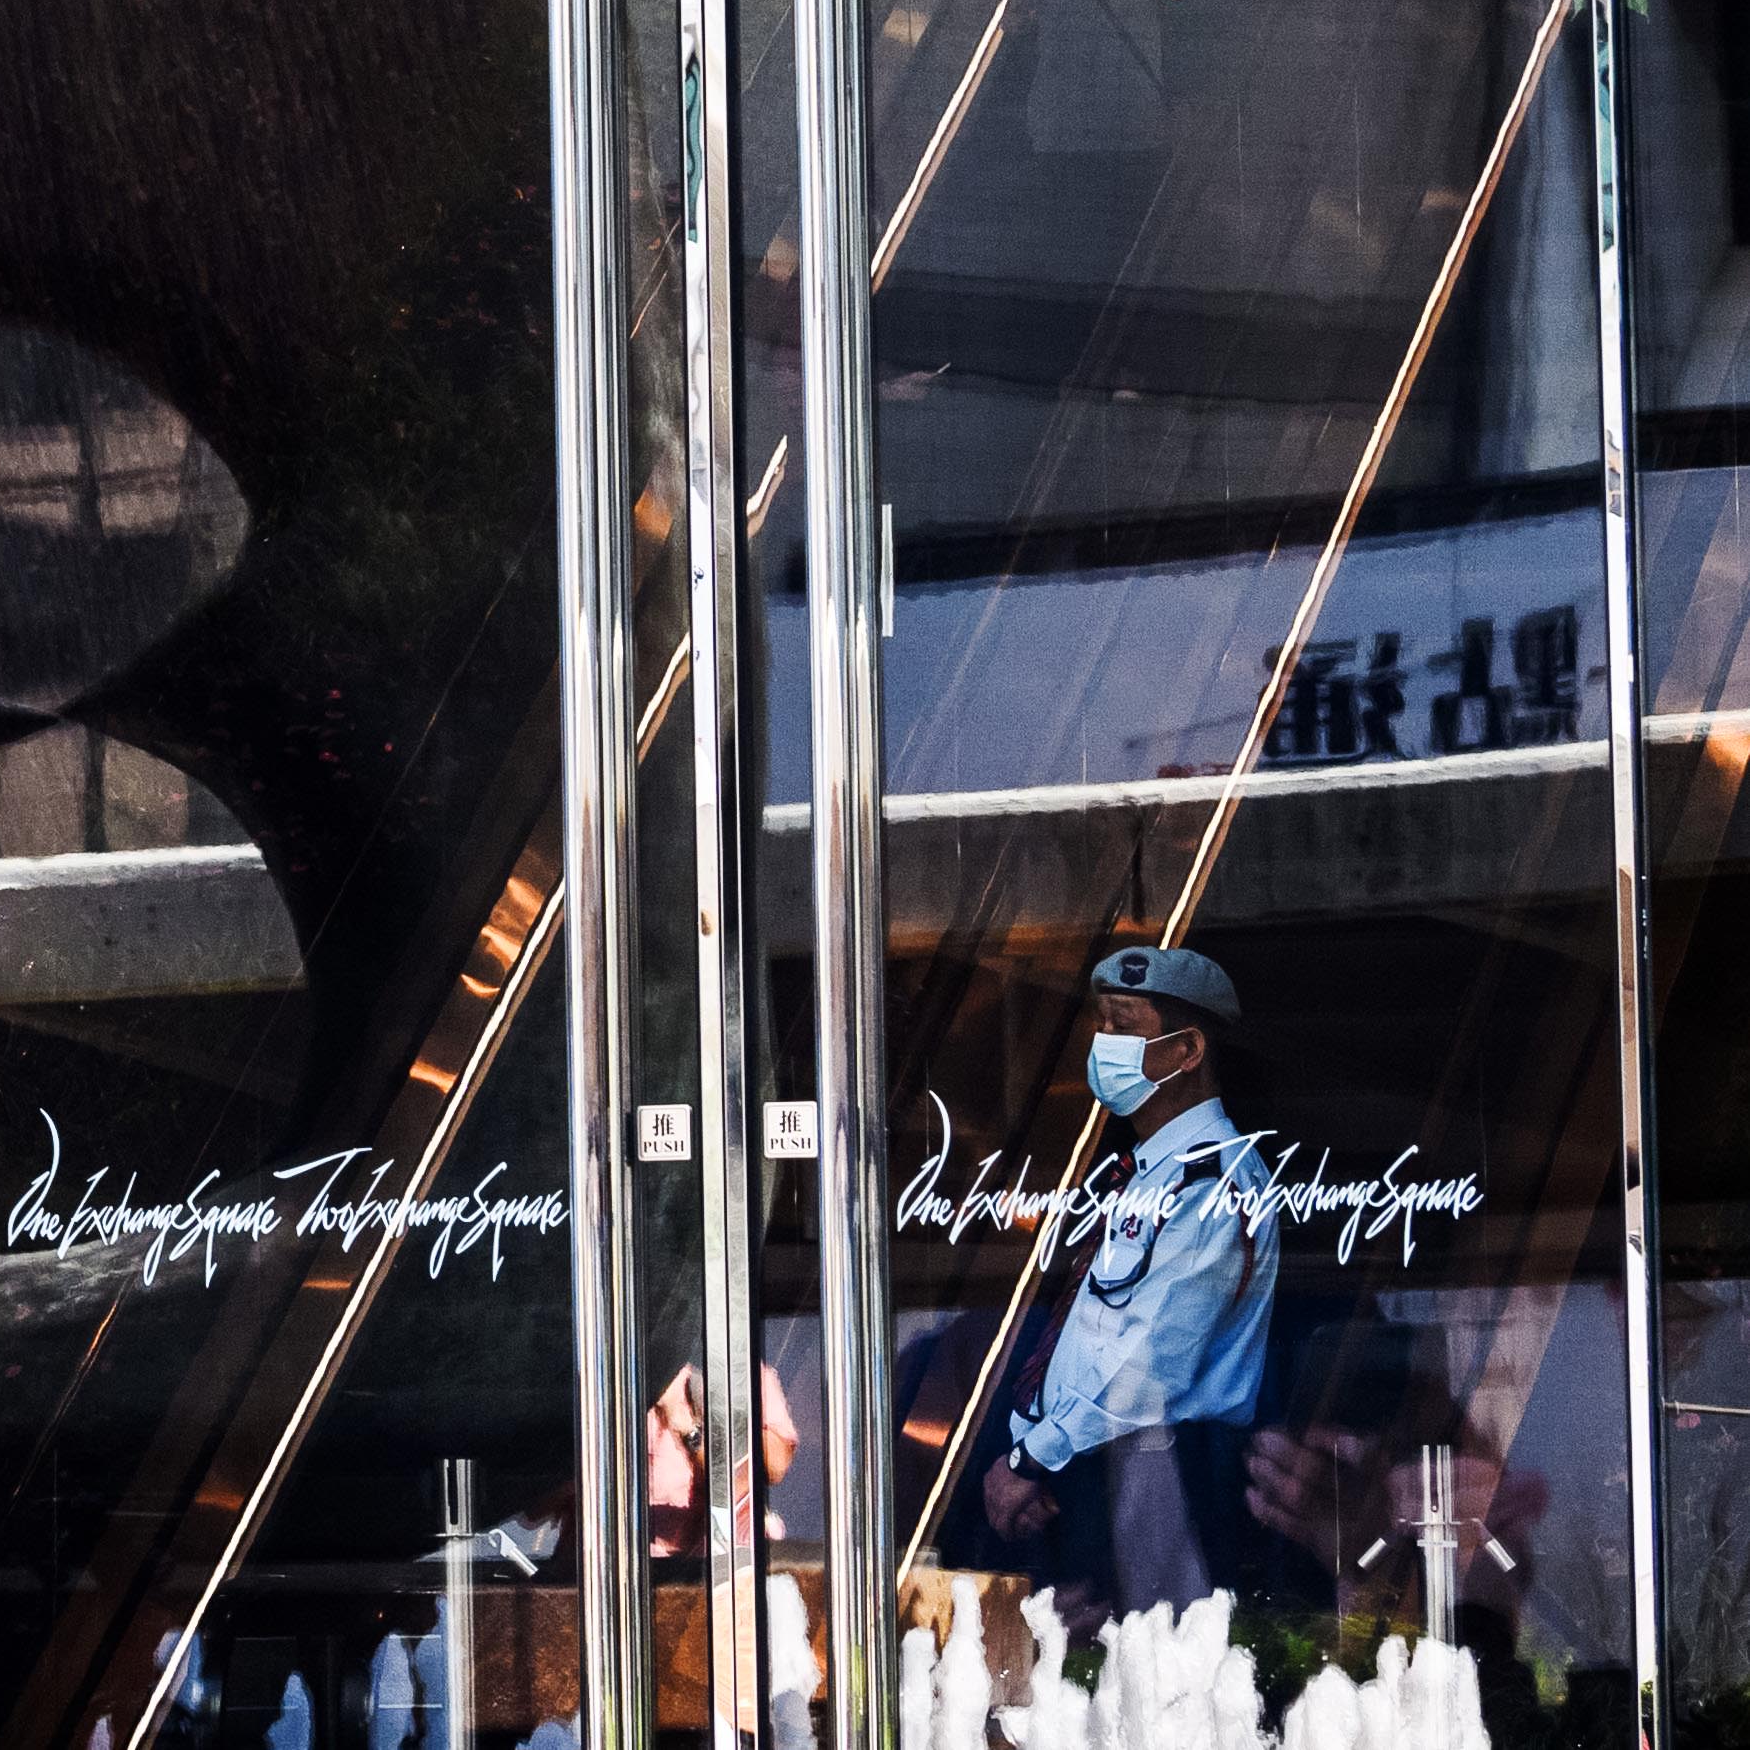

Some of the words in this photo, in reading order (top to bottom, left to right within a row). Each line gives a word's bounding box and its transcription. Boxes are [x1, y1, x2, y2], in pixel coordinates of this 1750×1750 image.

[652, 1113, 675, 1137] 推
[779, 1111, 802, 1134] 推
[643, 1140, 685, 1153] PUSH
[770, 1137, 812, 1150] PUSH
[897, 1089, 954, 1231] One
[949, 1150, 1078, 1271] Exchange
[1065, 1152, 1184, 1273] Square
[1174, 1130, 1277, 1223] Two
[1247, 1143, 1379, 1265] Exchange
[1366, 1145, 1484, 1268] Square
[8, 1108, 63, 1247] One
[59, 1166, 182, 1286] Exchange
[169, 1169, 282, 1288] Square
[274, 1148, 372, 1237] Two
[342, 1159, 468, 1279] Exchange
[455, 1162, 571, 1281] Square
